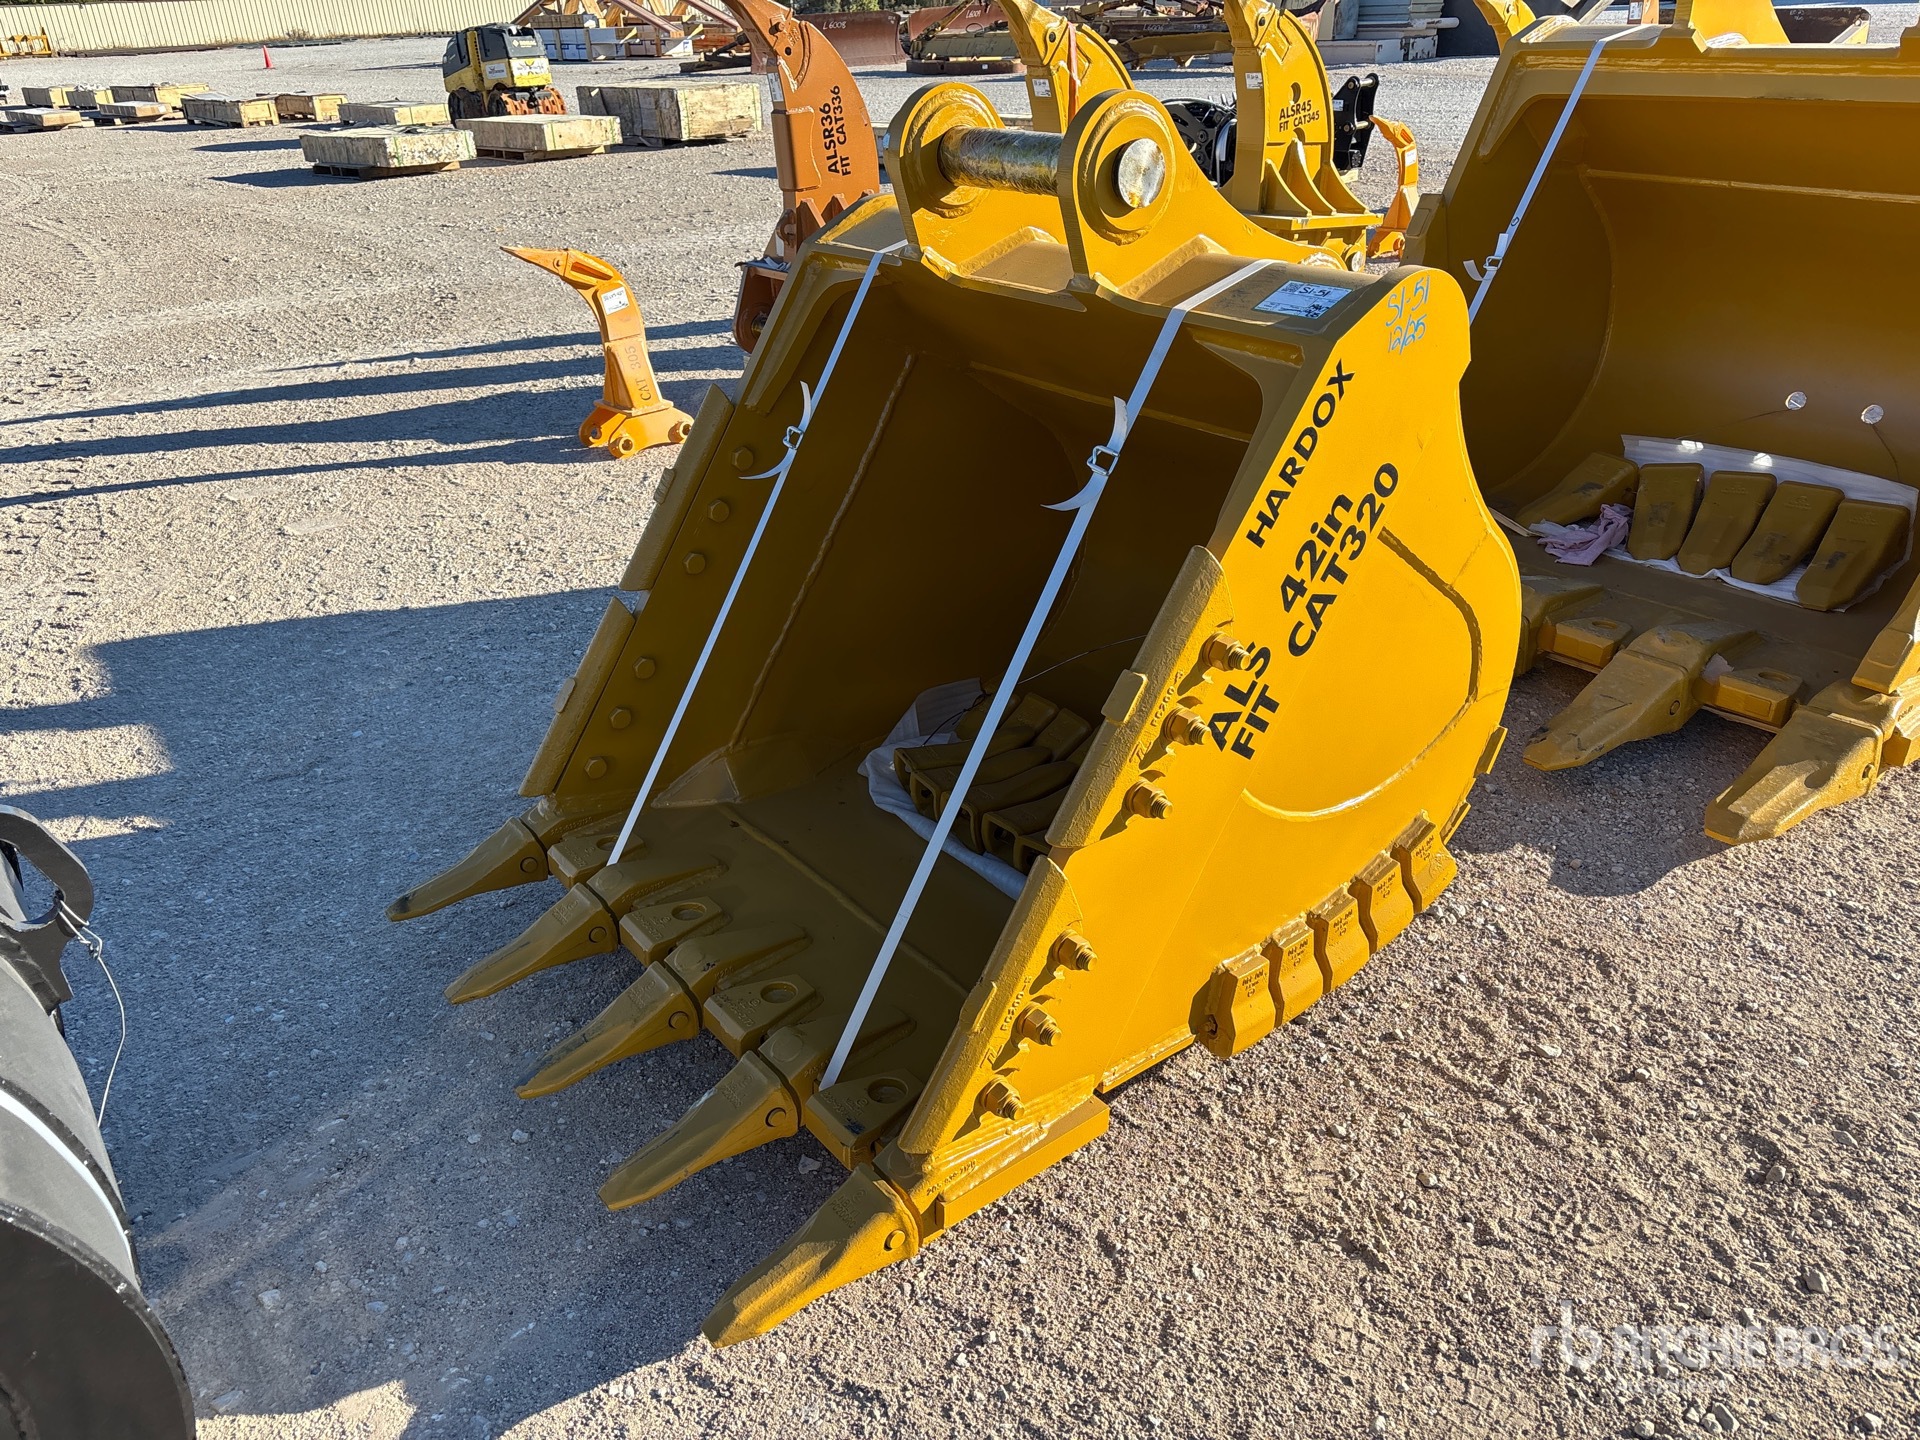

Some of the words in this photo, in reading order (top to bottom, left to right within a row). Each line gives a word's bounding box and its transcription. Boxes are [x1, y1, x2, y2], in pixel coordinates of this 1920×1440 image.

[830, 85, 847, 145] CAT336
[1279, 100, 1312, 121] ALSR45
[1279, 120, 1290, 133] FIT
[1293, 110, 1320, 128] CAT345
[819, 102, 840, 174] ALSR36
[840, 155, 852, 176] FIT
[1388, 314, 1427, 355] 12/25
[625, 345, 641, 370] 305
[635, 379, 652, 401] CAT
[1246, 358, 1355, 549] HARDOX
[1208, 641, 1272, 752] ALS
[1280, 493, 1354, 615] 42in
[1230, 684, 1281, 760] FIT
[1288, 462, 1399, 657] CAT320
